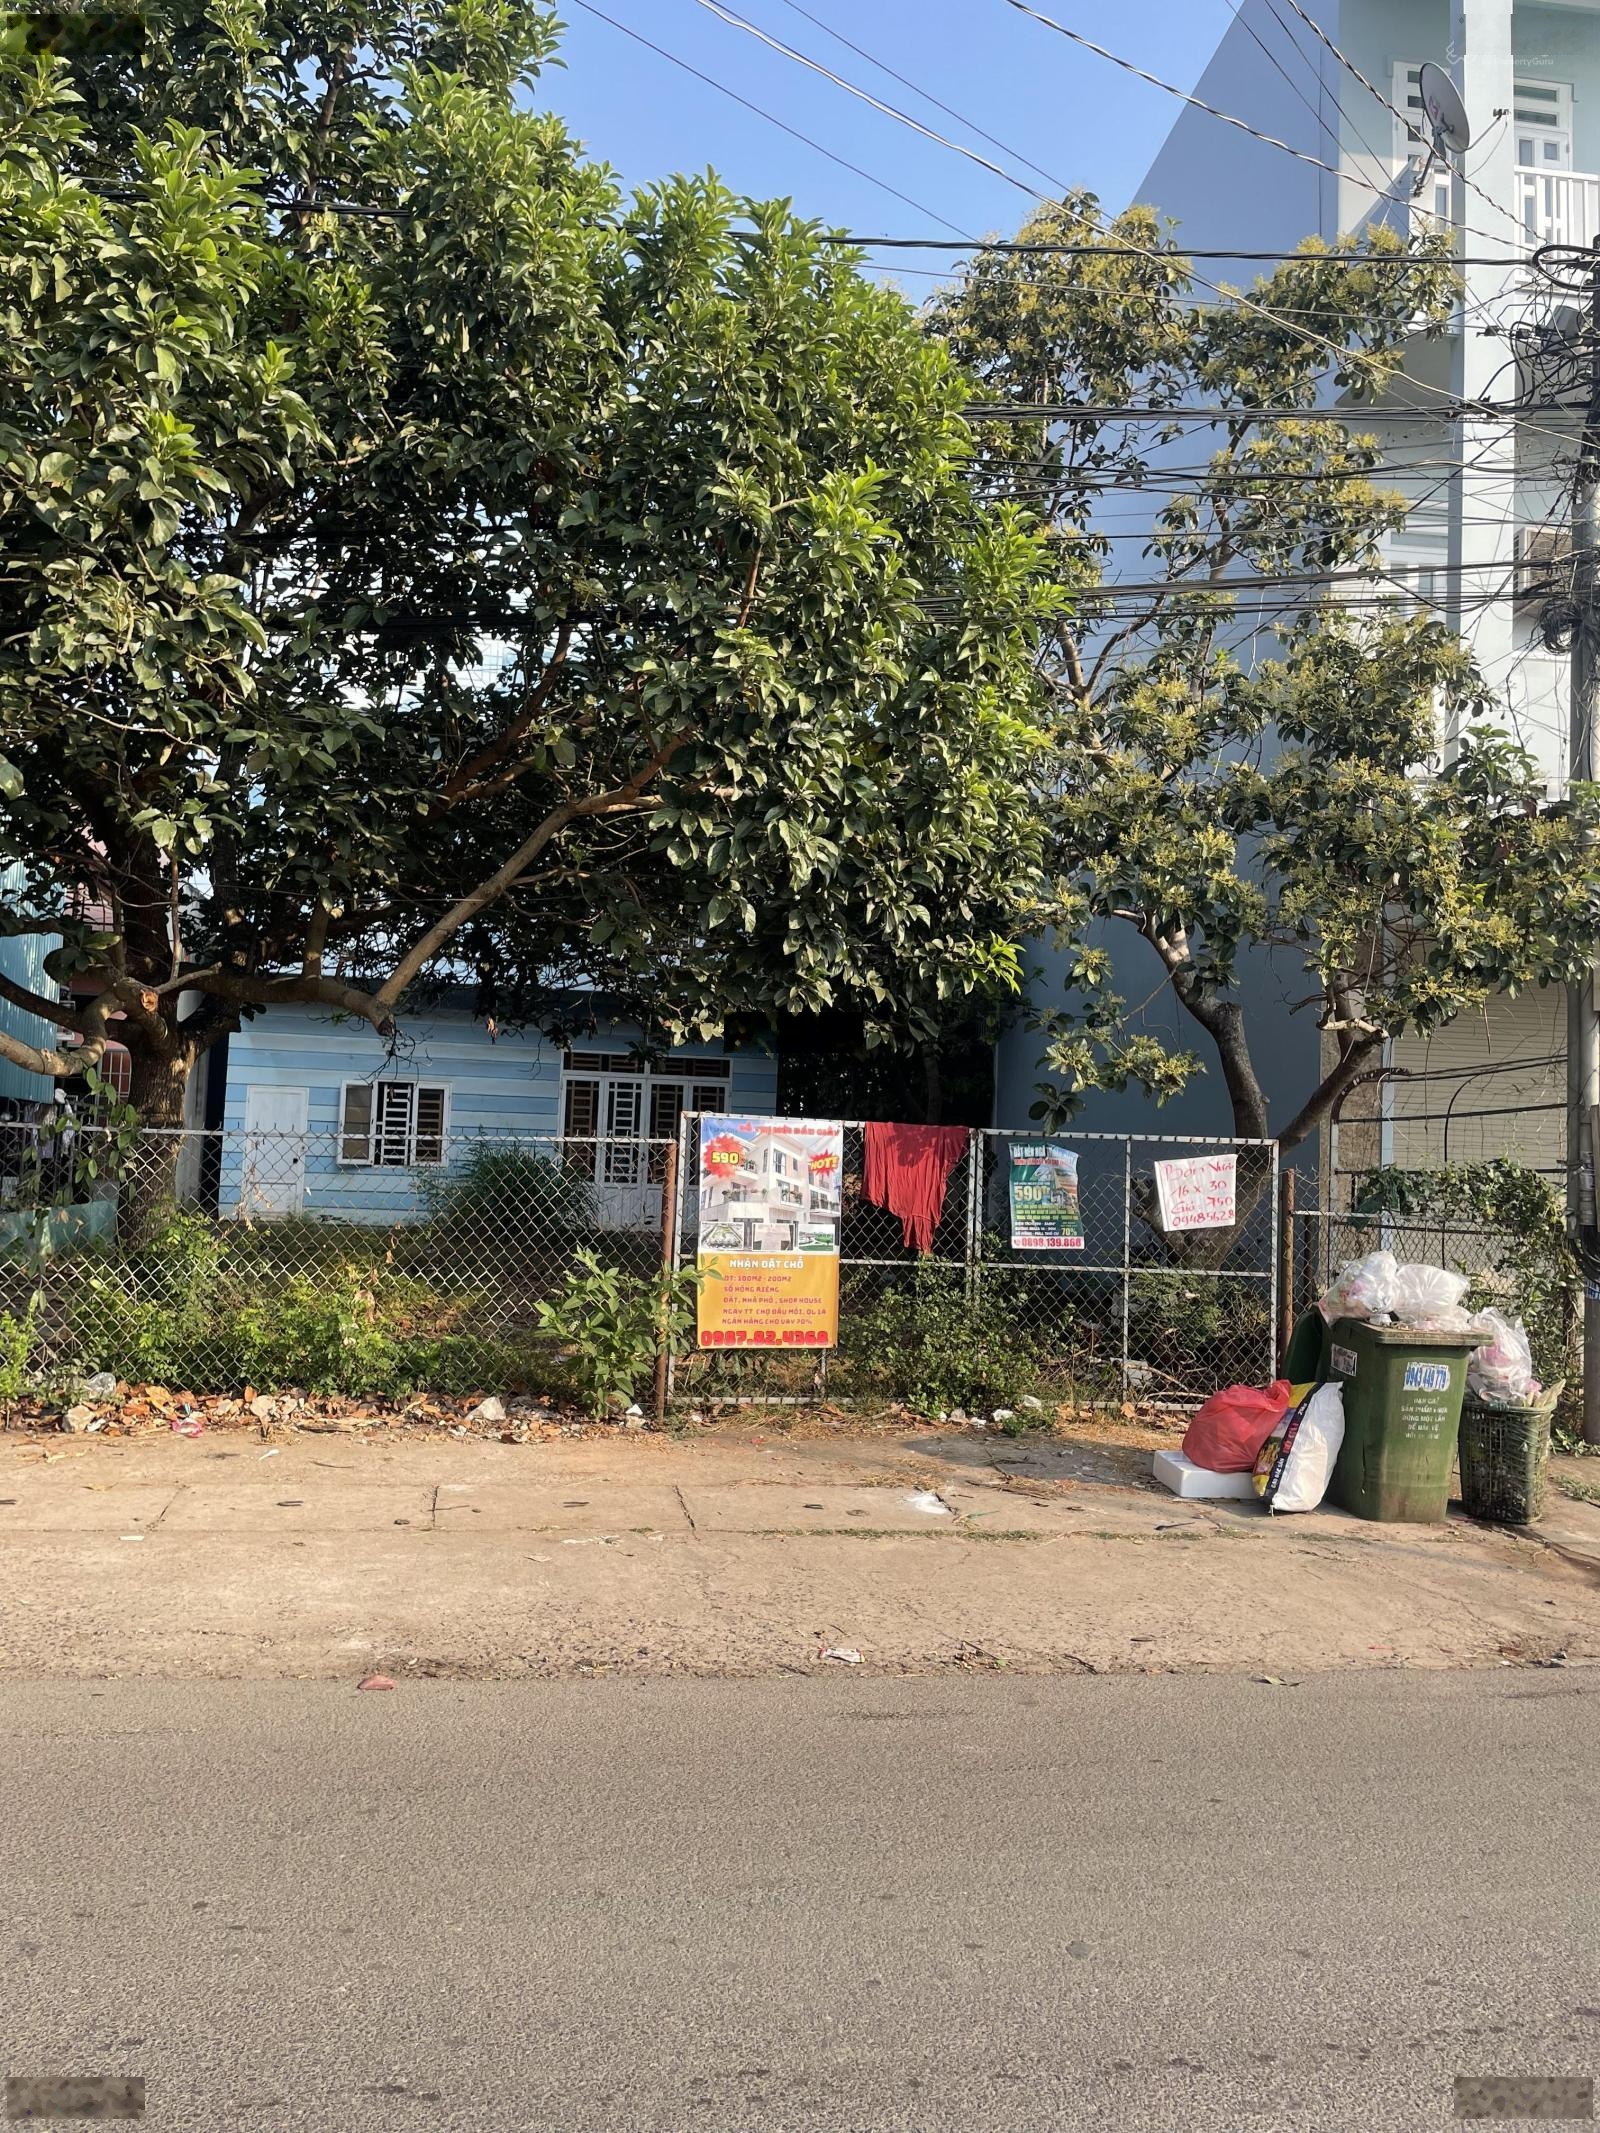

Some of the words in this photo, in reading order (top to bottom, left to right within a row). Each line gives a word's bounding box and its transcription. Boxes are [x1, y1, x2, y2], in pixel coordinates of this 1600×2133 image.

[711, 1151, 740, 1164] 590
[810, 1155, 839, 1170] HOT!
[1061, 1227, 1078, 1236] 70%
[729, 1257, 759, 1270] NHẬN
[700, 1330, 829, 1347] 0987.82.4368
